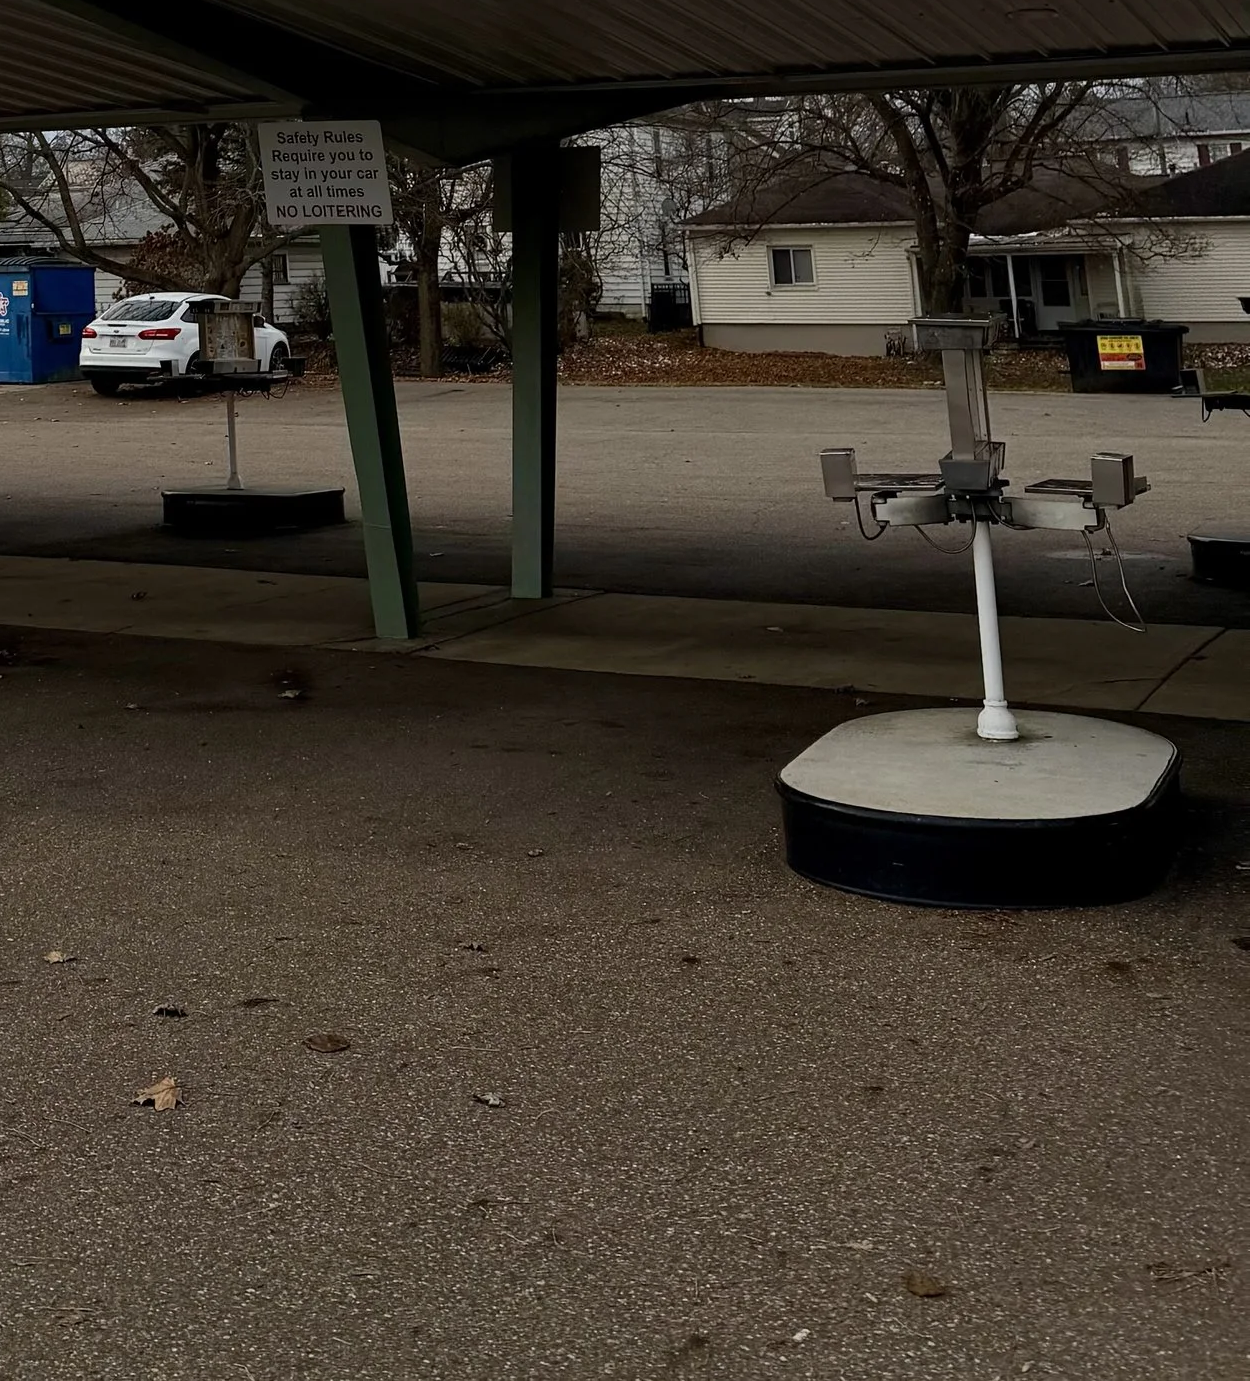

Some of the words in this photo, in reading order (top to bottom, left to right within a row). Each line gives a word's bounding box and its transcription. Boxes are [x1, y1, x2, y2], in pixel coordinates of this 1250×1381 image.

[277, 131, 319, 146] Safety
[324, 131, 363, 144] Rules
[272, 150, 325, 164] Require
[329, 151, 355, 164] you
[359, 149, 374, 161] to
[271, 169, 300, 182] stay
[305, 167, 317, 180] in
[322, 169, 352, 182] your
[357, 169, 379, 180] car
[290, 186, 302, 198] at
[306, 185, 322, 198] all
[326, 185, 365, 198] times
[276, 205, 298, 218] NO
[303, 205, 382, 218] LOITERING
